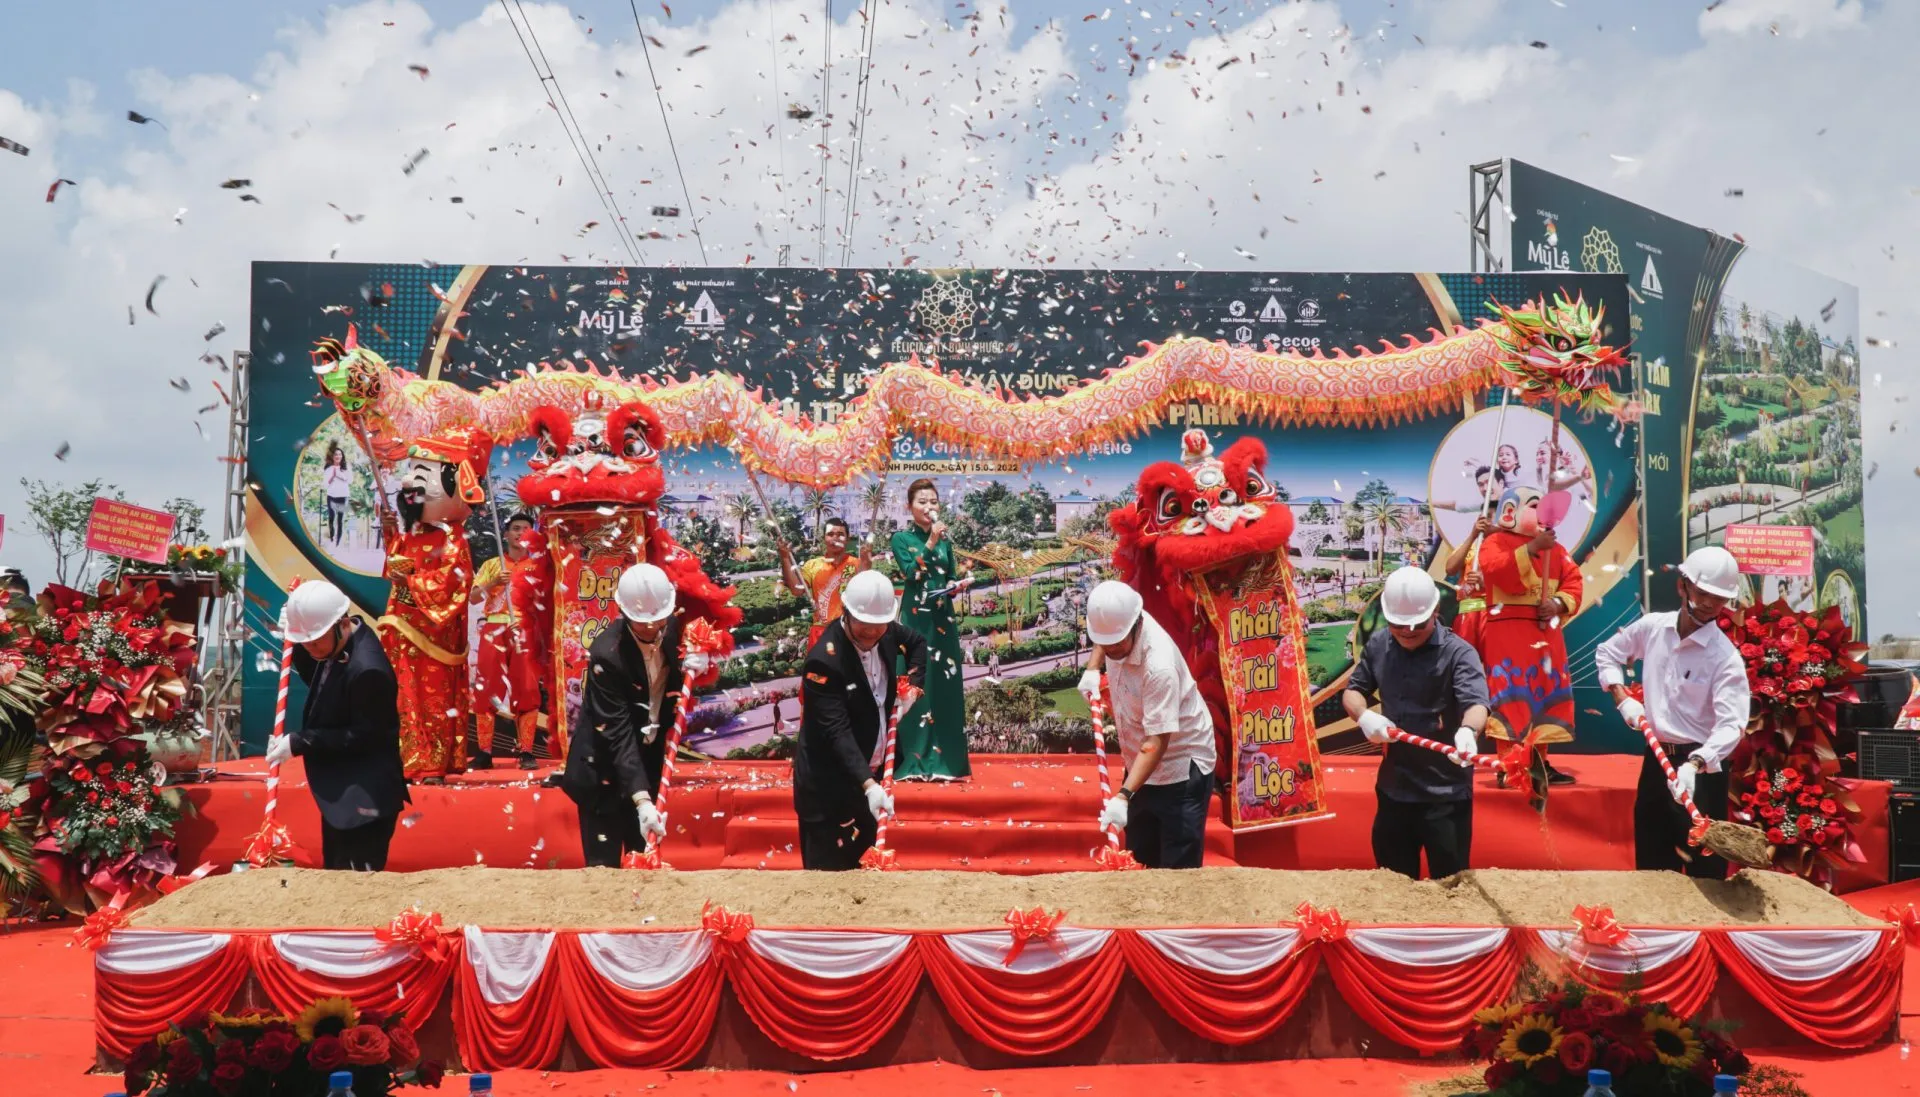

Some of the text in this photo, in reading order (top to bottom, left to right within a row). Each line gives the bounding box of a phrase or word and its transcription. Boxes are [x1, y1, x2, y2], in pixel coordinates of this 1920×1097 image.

[891, 341, 926, 353] FELICIA
[1282, 337, 1320, 347] ecoe
[1170, 404, 1239, 425] PARK
[1748, 557, 1782, 566] CENTRAL
[1230, 601, 1280, 644] Phát
[1242, 654, 1277, 692] Tài
[1242, 707, 1294, 746] Phát
[1253, 762, 1294, 806] Lộc
